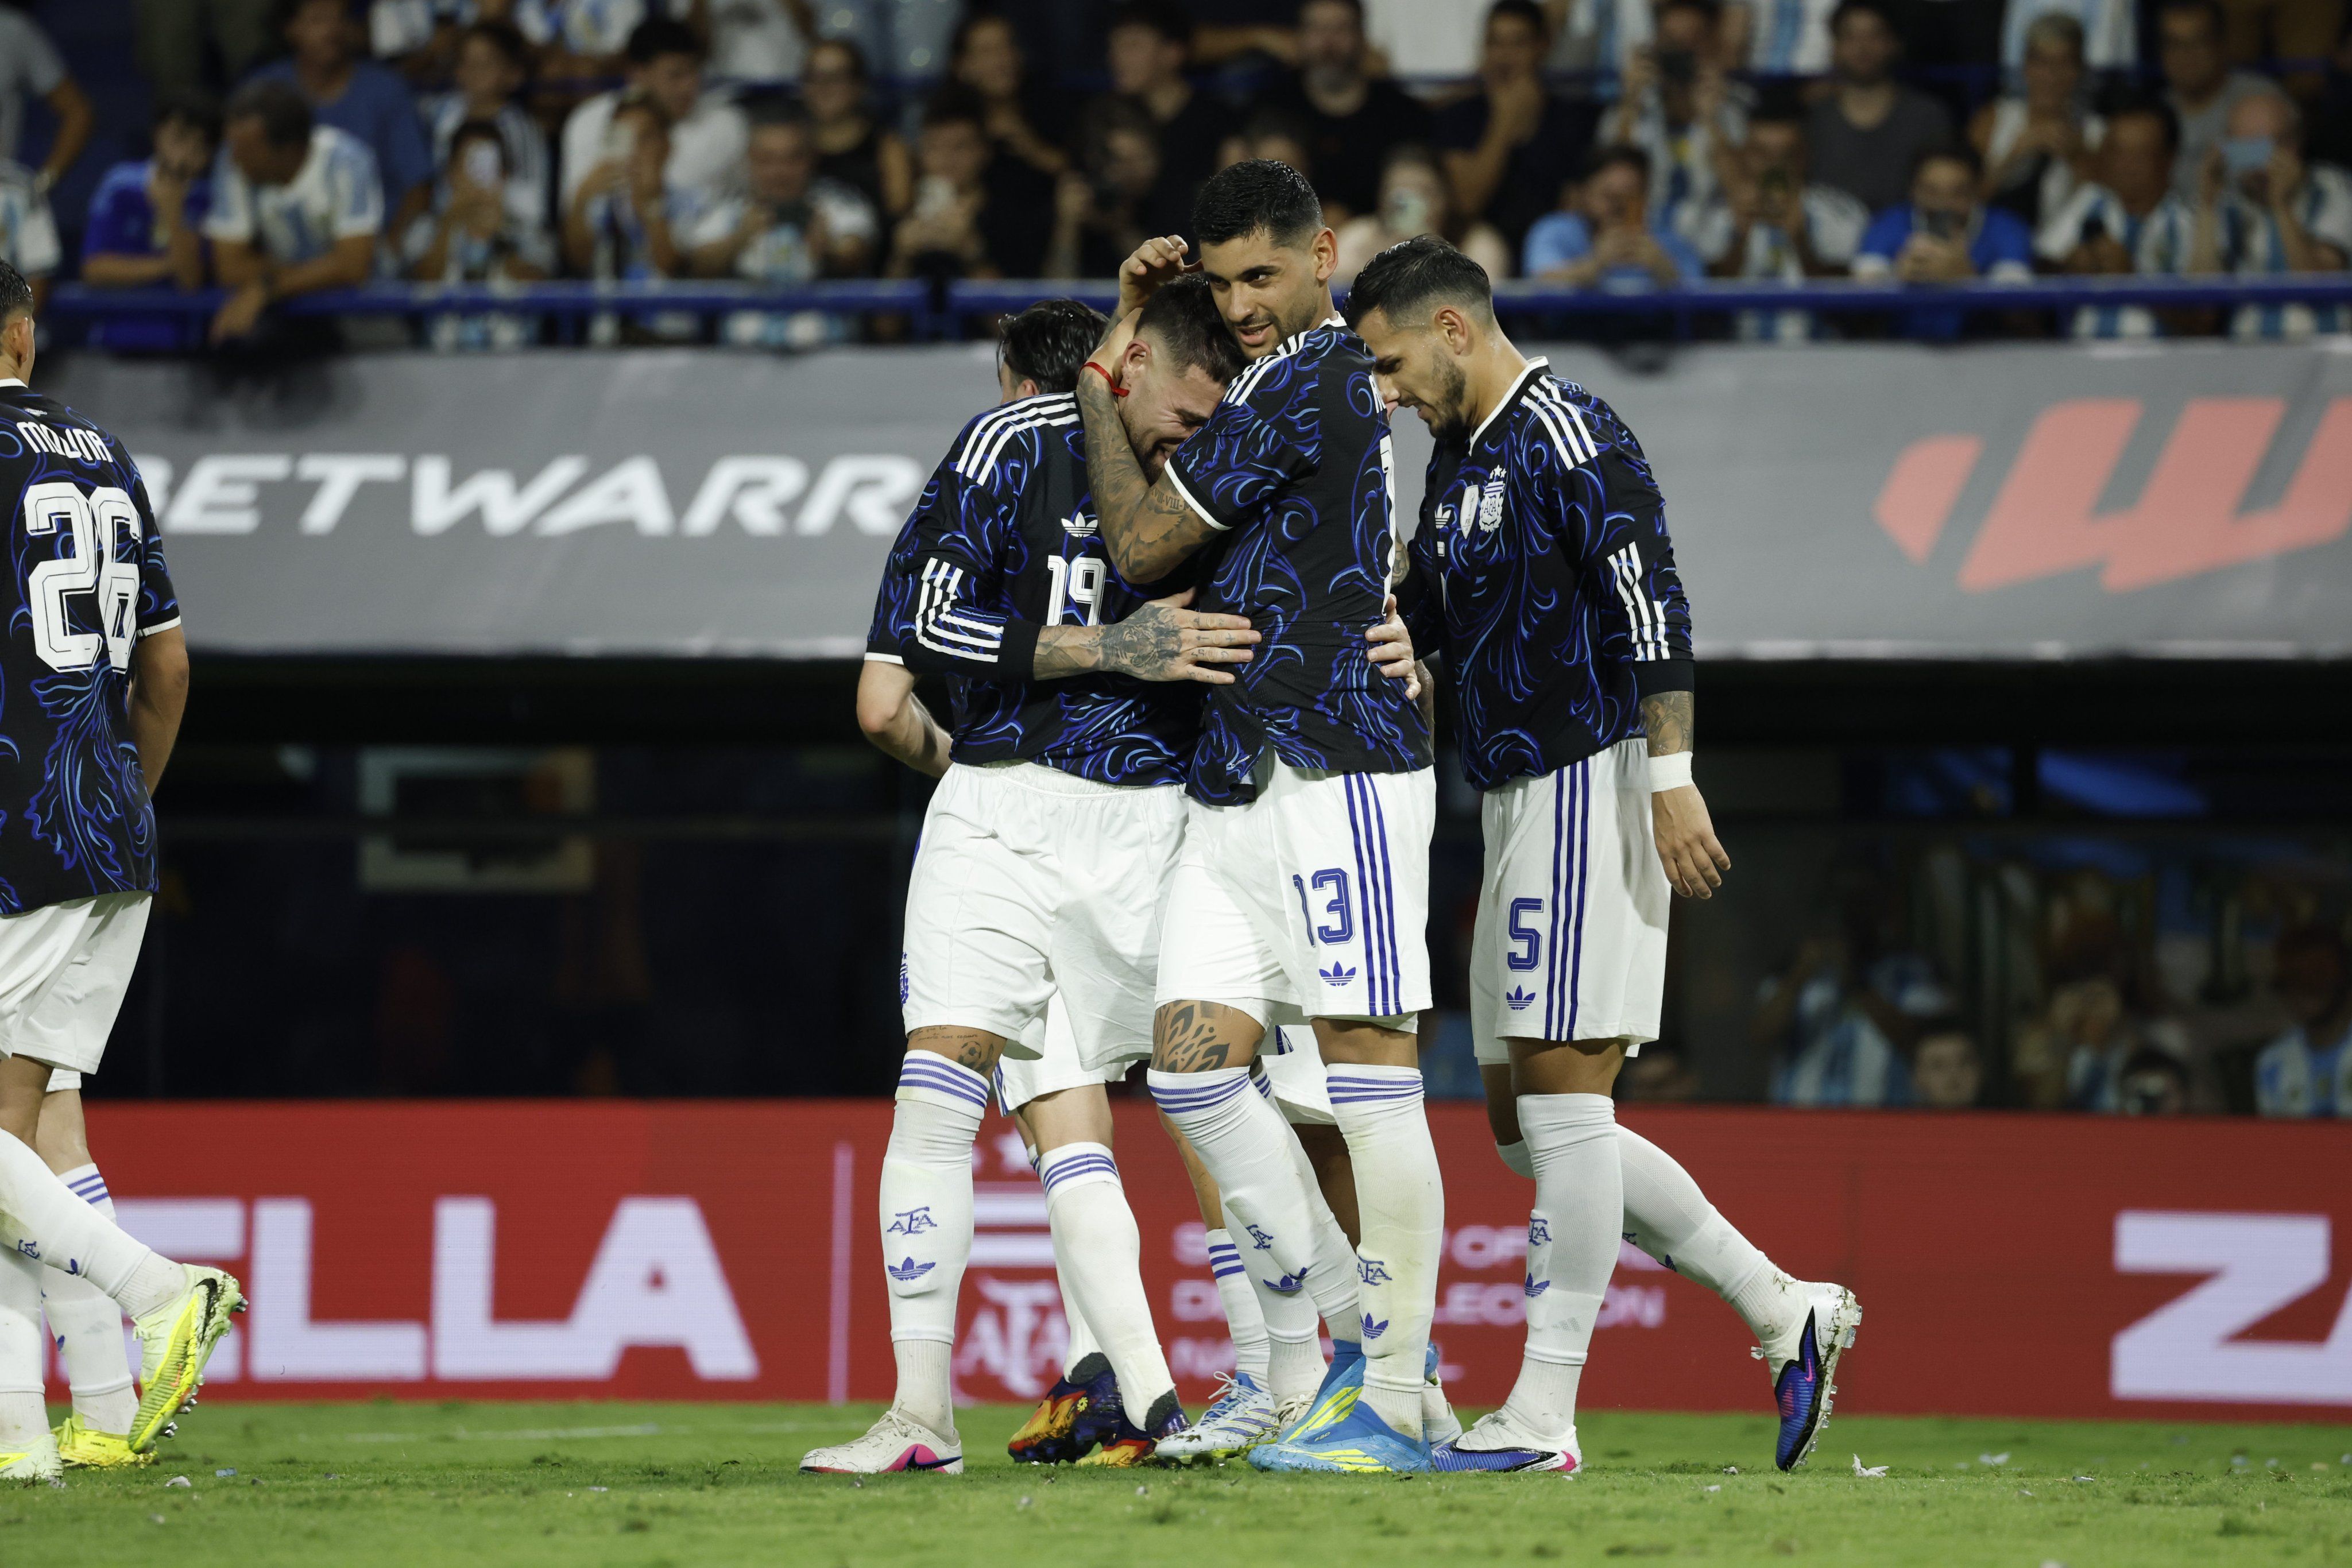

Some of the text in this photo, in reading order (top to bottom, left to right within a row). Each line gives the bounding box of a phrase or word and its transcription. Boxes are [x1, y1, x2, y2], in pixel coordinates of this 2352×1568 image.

[24, 482, 142, 675] 26
[1047, 555, 1107, 626] 19
[1293, 868, 1356, 948] 13
[1507, 897, 1543, 972] 5
[887, 1206, 937, 1235] AFA
[1529, 1218, 1552, 1246] FA
[2110, 1208, 2352, 1406] Z
